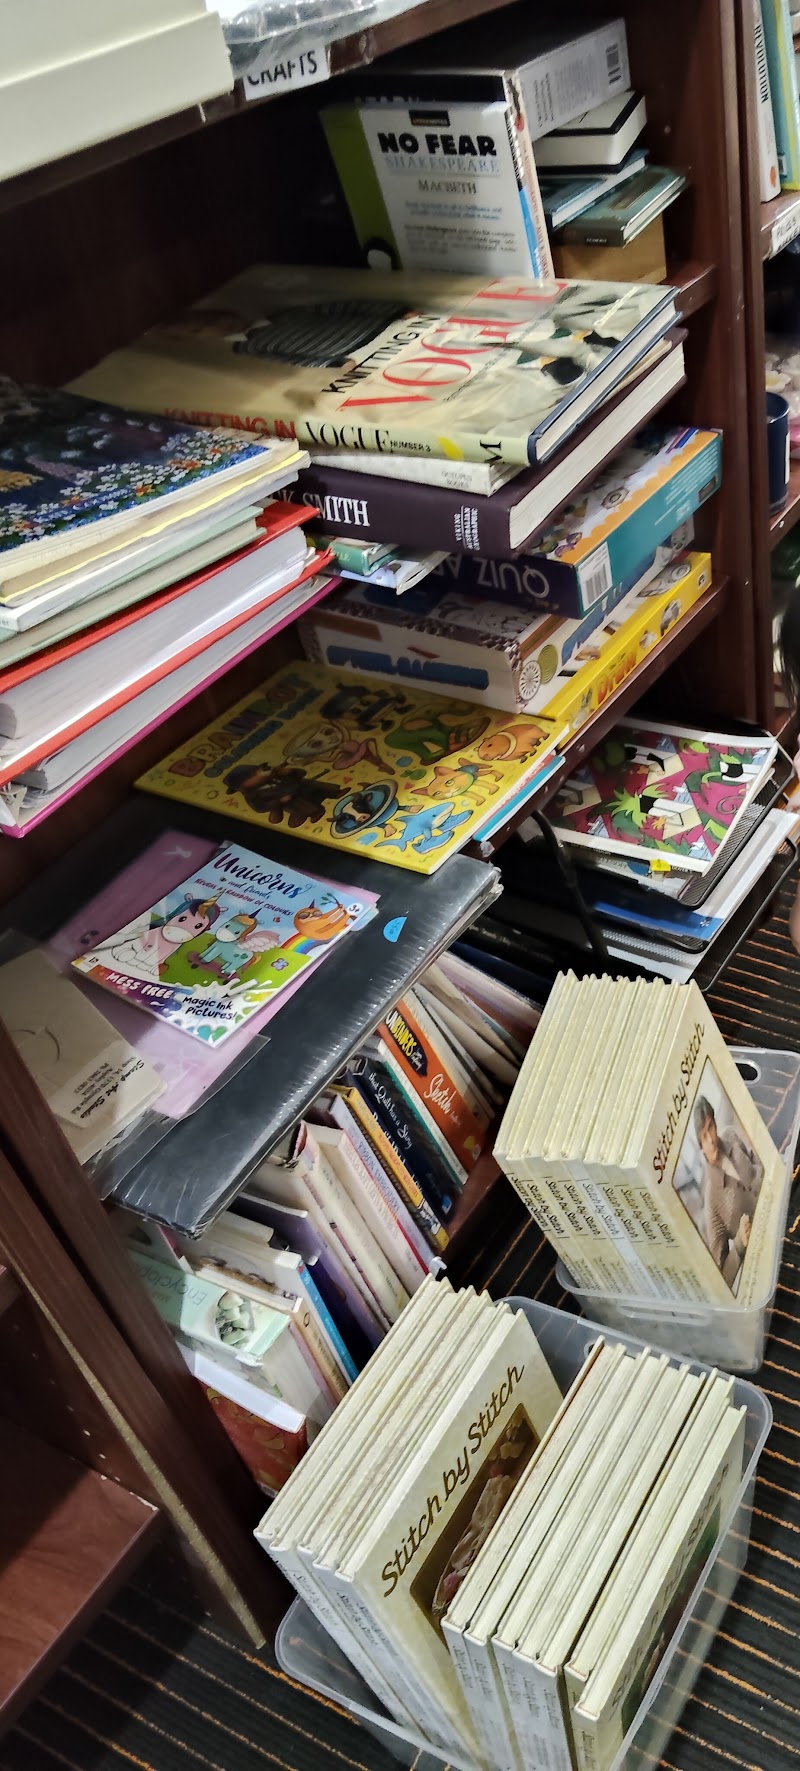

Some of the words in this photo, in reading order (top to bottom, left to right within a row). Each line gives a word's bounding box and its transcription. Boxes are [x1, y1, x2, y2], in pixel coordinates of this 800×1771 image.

[377, 132, 419, 154] NO
[425, 134, 497, 157] FEAR
[385, 156, 500, 173] SHAKESPEARE
[418, 180, 477, 194] MACBETH
[321, 331, 420, 393] KNITTING
[416, 314, 441, 330] IN
[338, 279, 569, 411] VOGUE
[274, 419, 297, 439] IN
[304, 421, 390, 454] VOGUE
[390, 440, 424, 451] NUMBER
[302, 493, 370, 527] SMITH
[473, 557, 549, 598] QUIZ
[213, 853, 302, 898] Unicorns
[194, 878, 216, 889] REVEAL
[226, 889, 255, 903] RAINBOW
[106, 972, 141, 990] MESS
[141, 984, 175, 999] FREE
[183, 996, 215, 1008] Magic
[217, 1001, 234, 1011] Ink
[185, 1006, 238, 1021] Pictures!
[680, 1022, 705, 1087] Stitch
[120, 1059, 145, 1082] Stamp
[366, 1071, 383, 1090] that
[105, 1081, 119, 1096] Art
[371, 1085, 394, 1110] Quilt
[80, 1096, 105, 1119] Studio
[386, 1104, 402, 1121] has
[674, 1084, 689, 1120] by
[394, 1123, 418, 1150] Story
[653, 1112, 675, 1184] Stitch
[381, 1497, 442, 1598] Stitch
[444, 1444, 471, 1502] by
[466, 1364, 526, 1455] Stitch
